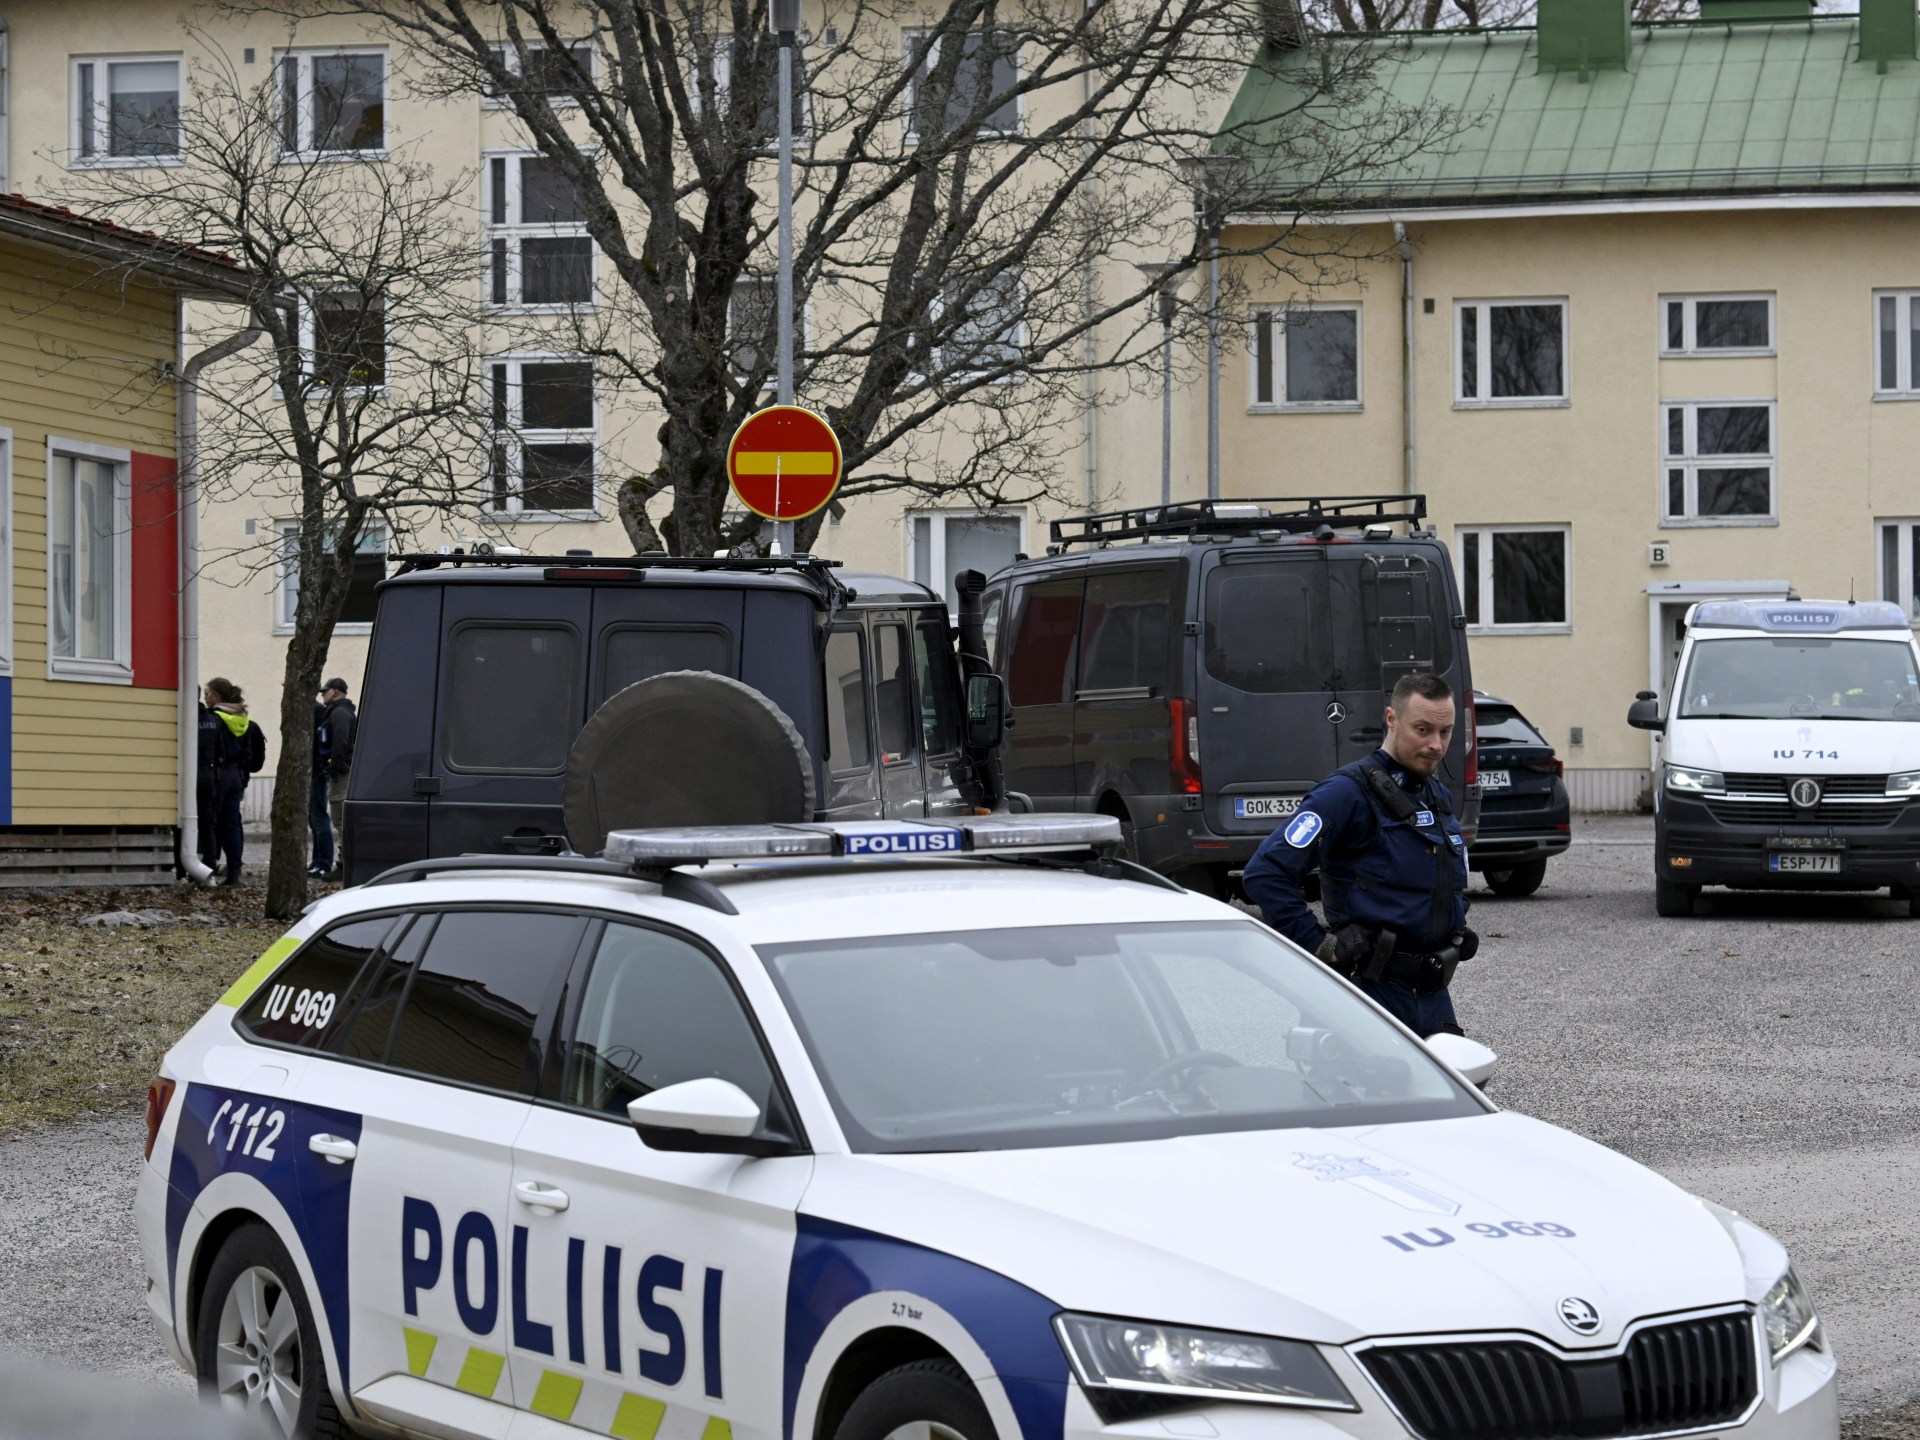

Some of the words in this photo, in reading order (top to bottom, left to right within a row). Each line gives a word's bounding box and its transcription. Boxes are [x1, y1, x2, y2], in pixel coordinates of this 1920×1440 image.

[1653, 548, 1664, 561] B
[1773, 614, 1830, 623] POLIISI
[1773, 750, 1795, 759] IU
[1802, 750, 1840, 760] 714
[850, 834, 955, 853] POLIISI
[262, 984, 295, 1020] IU
[291, 988, 336, 1029] 969
[226, 1103, 286, 1161] 112
[1381, 1227, 1456, 1252] IU
[1465, 1221, 1576, 1238] 969
[402, 1196, 723, 1399] POLIISI
[892, 1302, 906, 1317] 2,7
[908, 1305, 923, 1321] bar
